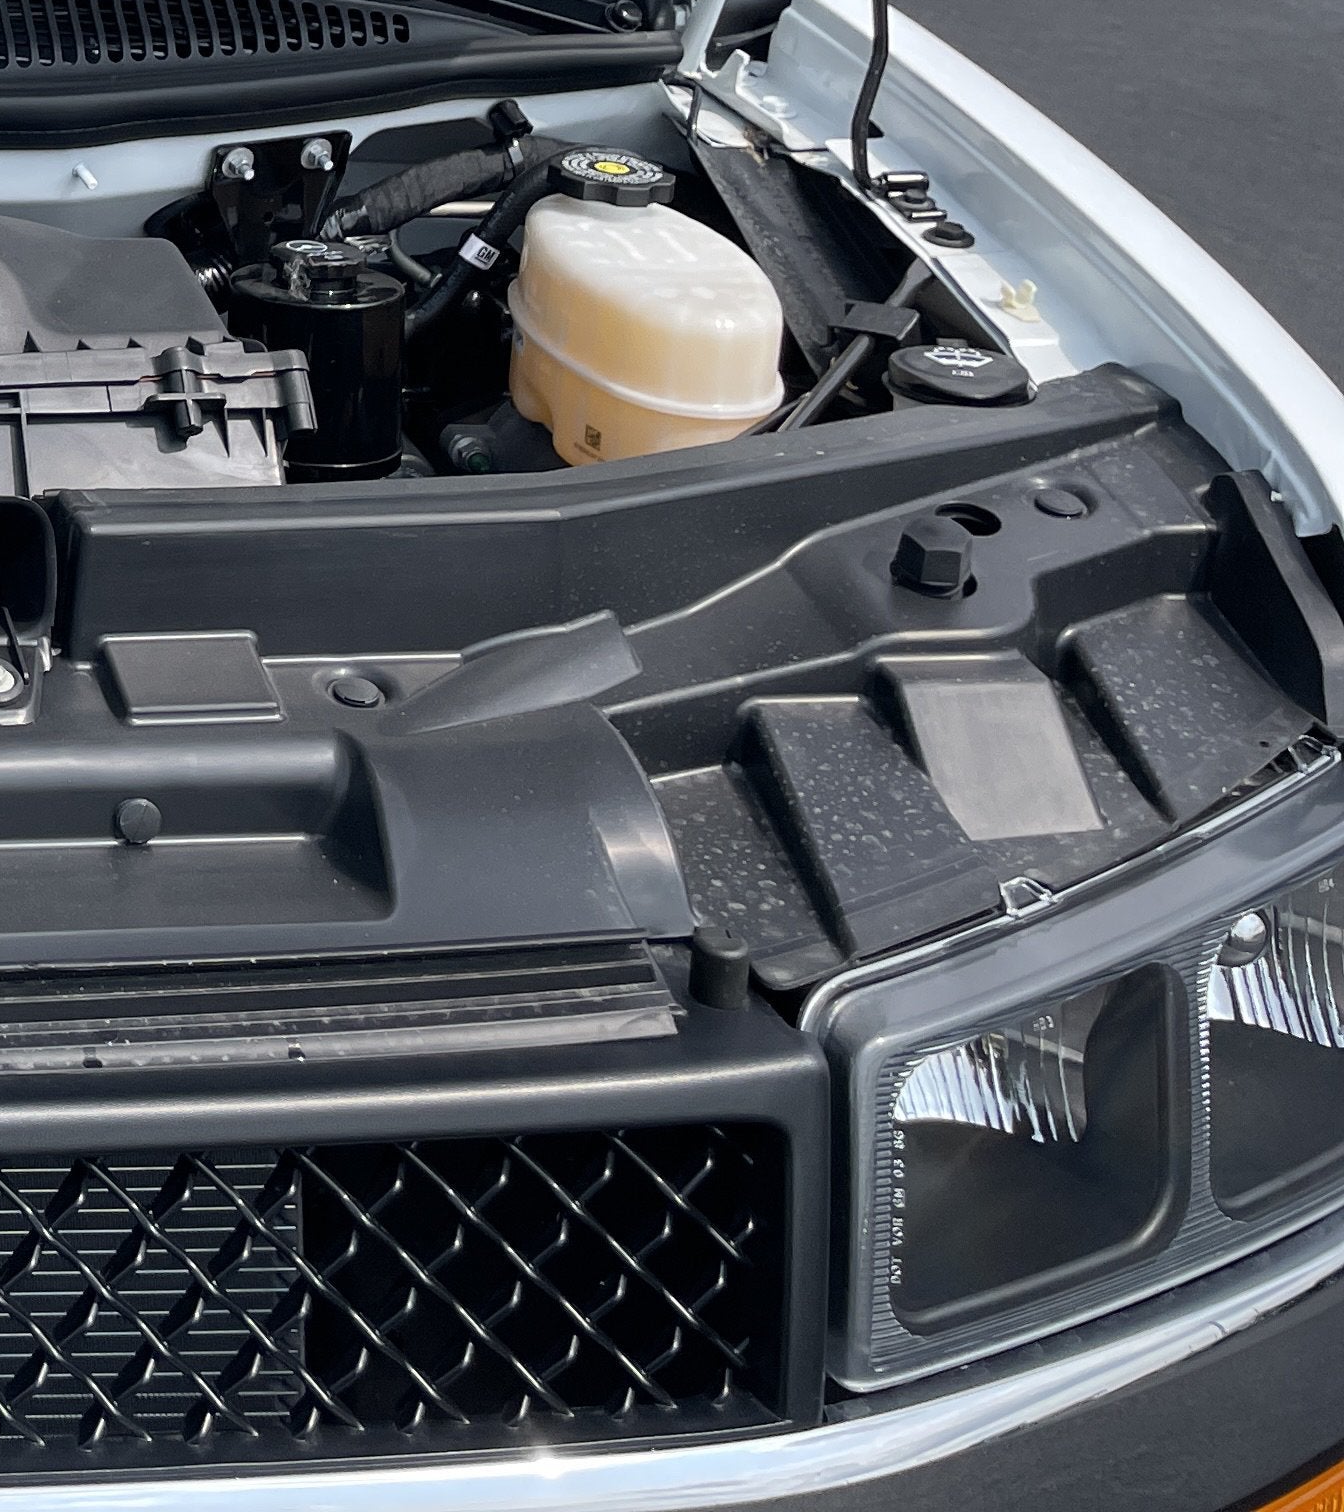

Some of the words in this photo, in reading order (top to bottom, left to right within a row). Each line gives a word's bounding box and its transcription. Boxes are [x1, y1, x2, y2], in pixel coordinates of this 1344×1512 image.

[477, 246, 496, 263] GM
[891, 1218, 904, 1246] VOR
[890, 1257, 903, 1284] DOT
